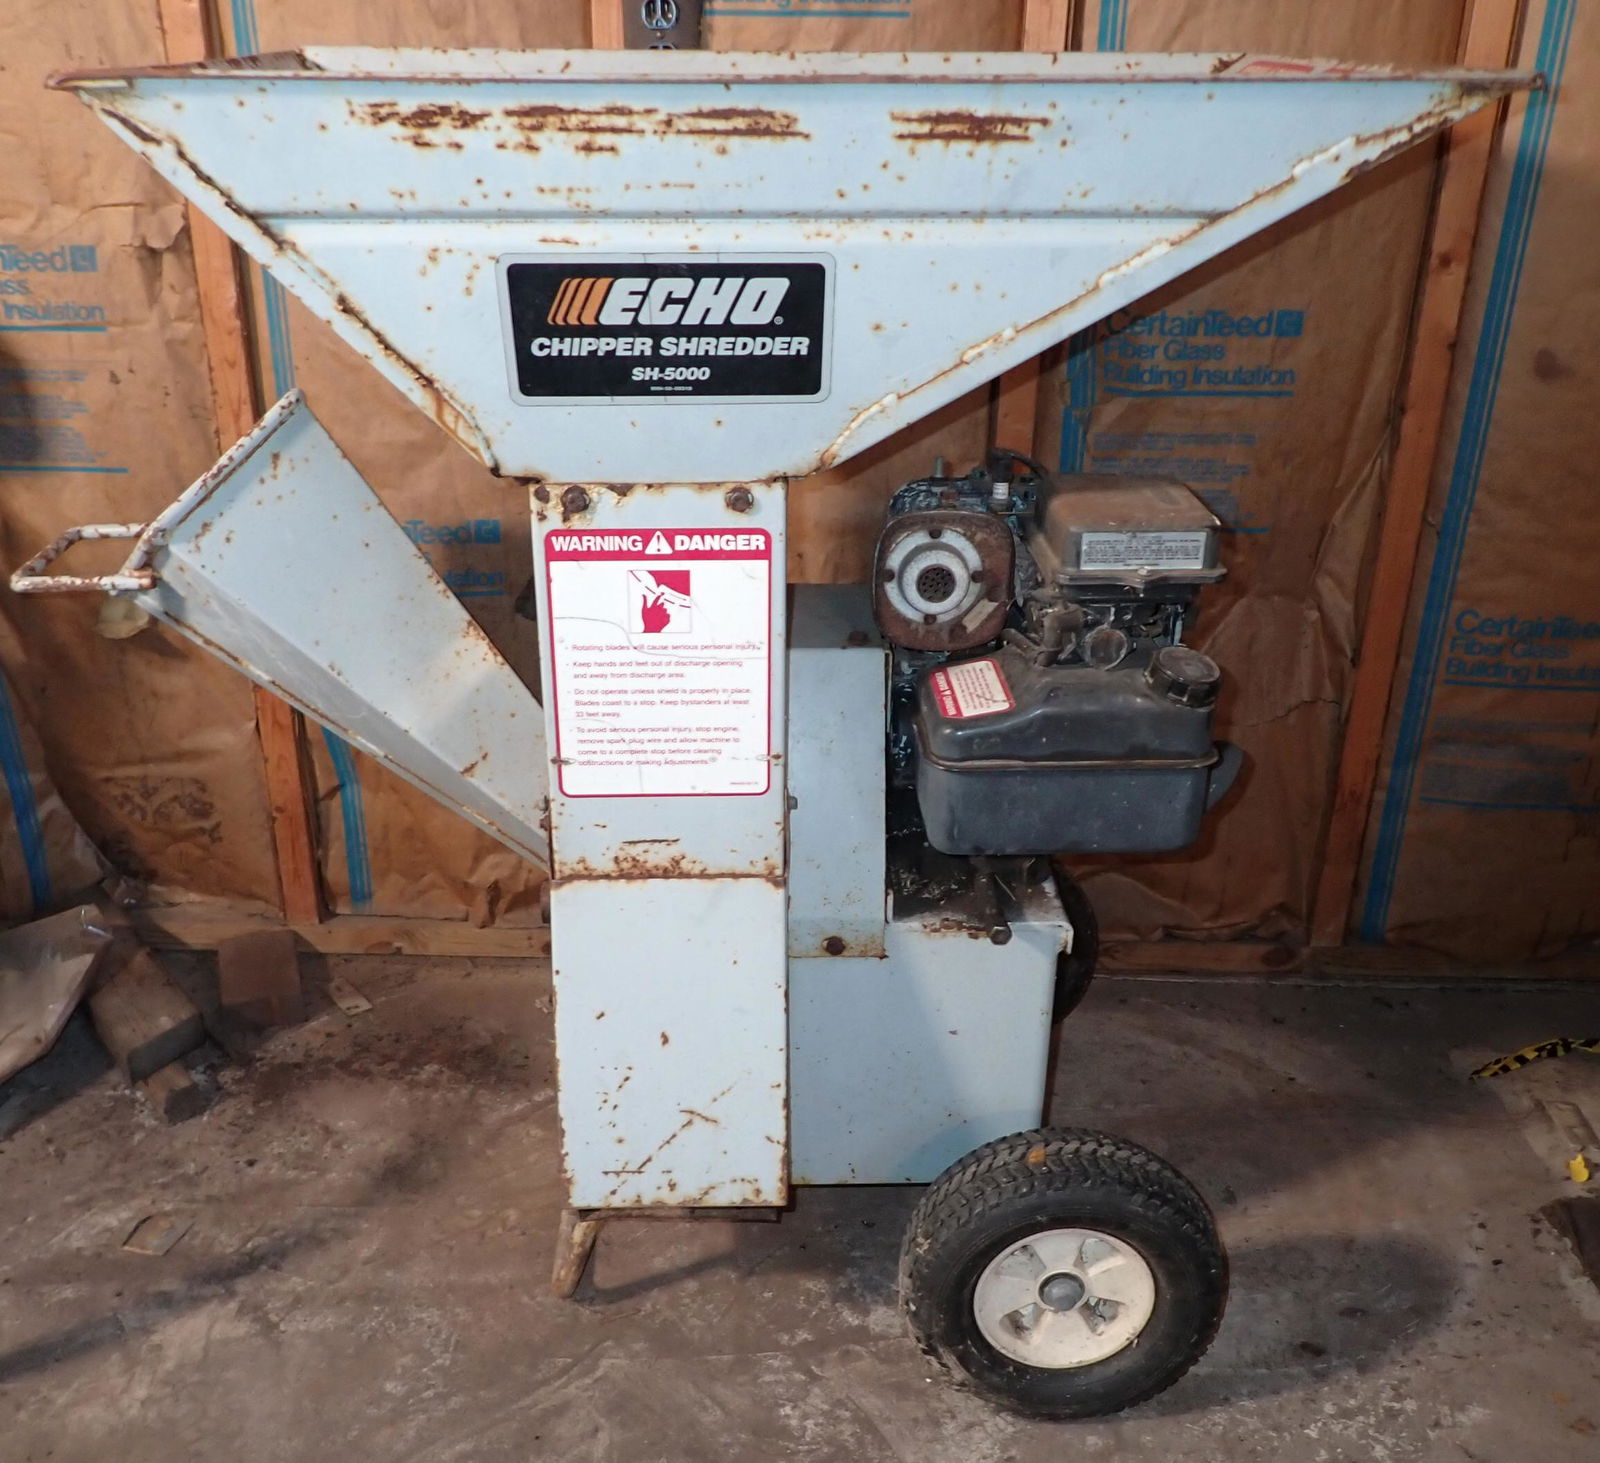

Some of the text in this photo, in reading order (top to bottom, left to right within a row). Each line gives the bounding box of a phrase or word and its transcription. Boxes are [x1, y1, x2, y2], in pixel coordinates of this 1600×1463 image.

[599, 277, 790, 325] ECHO
[4, 301, 105, 321] Insulation
[1106, 309, 1274, 338] CertainTeed
[530, 336, 810, 357] CHIPPER SHREDDER
[1163, 339, 1226, 362] Glass
[631, 366, 711, 381] SH-5000
[1103, 362, 1296, 389] Building Insulation
[551, 534, 766, 552] WARNING DANGER
[672, 643, 698, 651] serious
[701, 643, 732, 652] personal
[674, 660, 710, 668] discharge
[712, 660, 743, 668] opening
[629, 672, 665, 680] discharge
[601, 688, 628, 696] operate
[689, 688, 719, 696] properly
[680, 699, 721, 707] bystanders
[638, 726, 669, 734] personal
[680, 736, 698, 744] allow
[700, 736, 731, 744] machine
[615, 748, 648, 756] complete
[651, 748, 665, 756] stop
[636, 759, 661, 767] making
